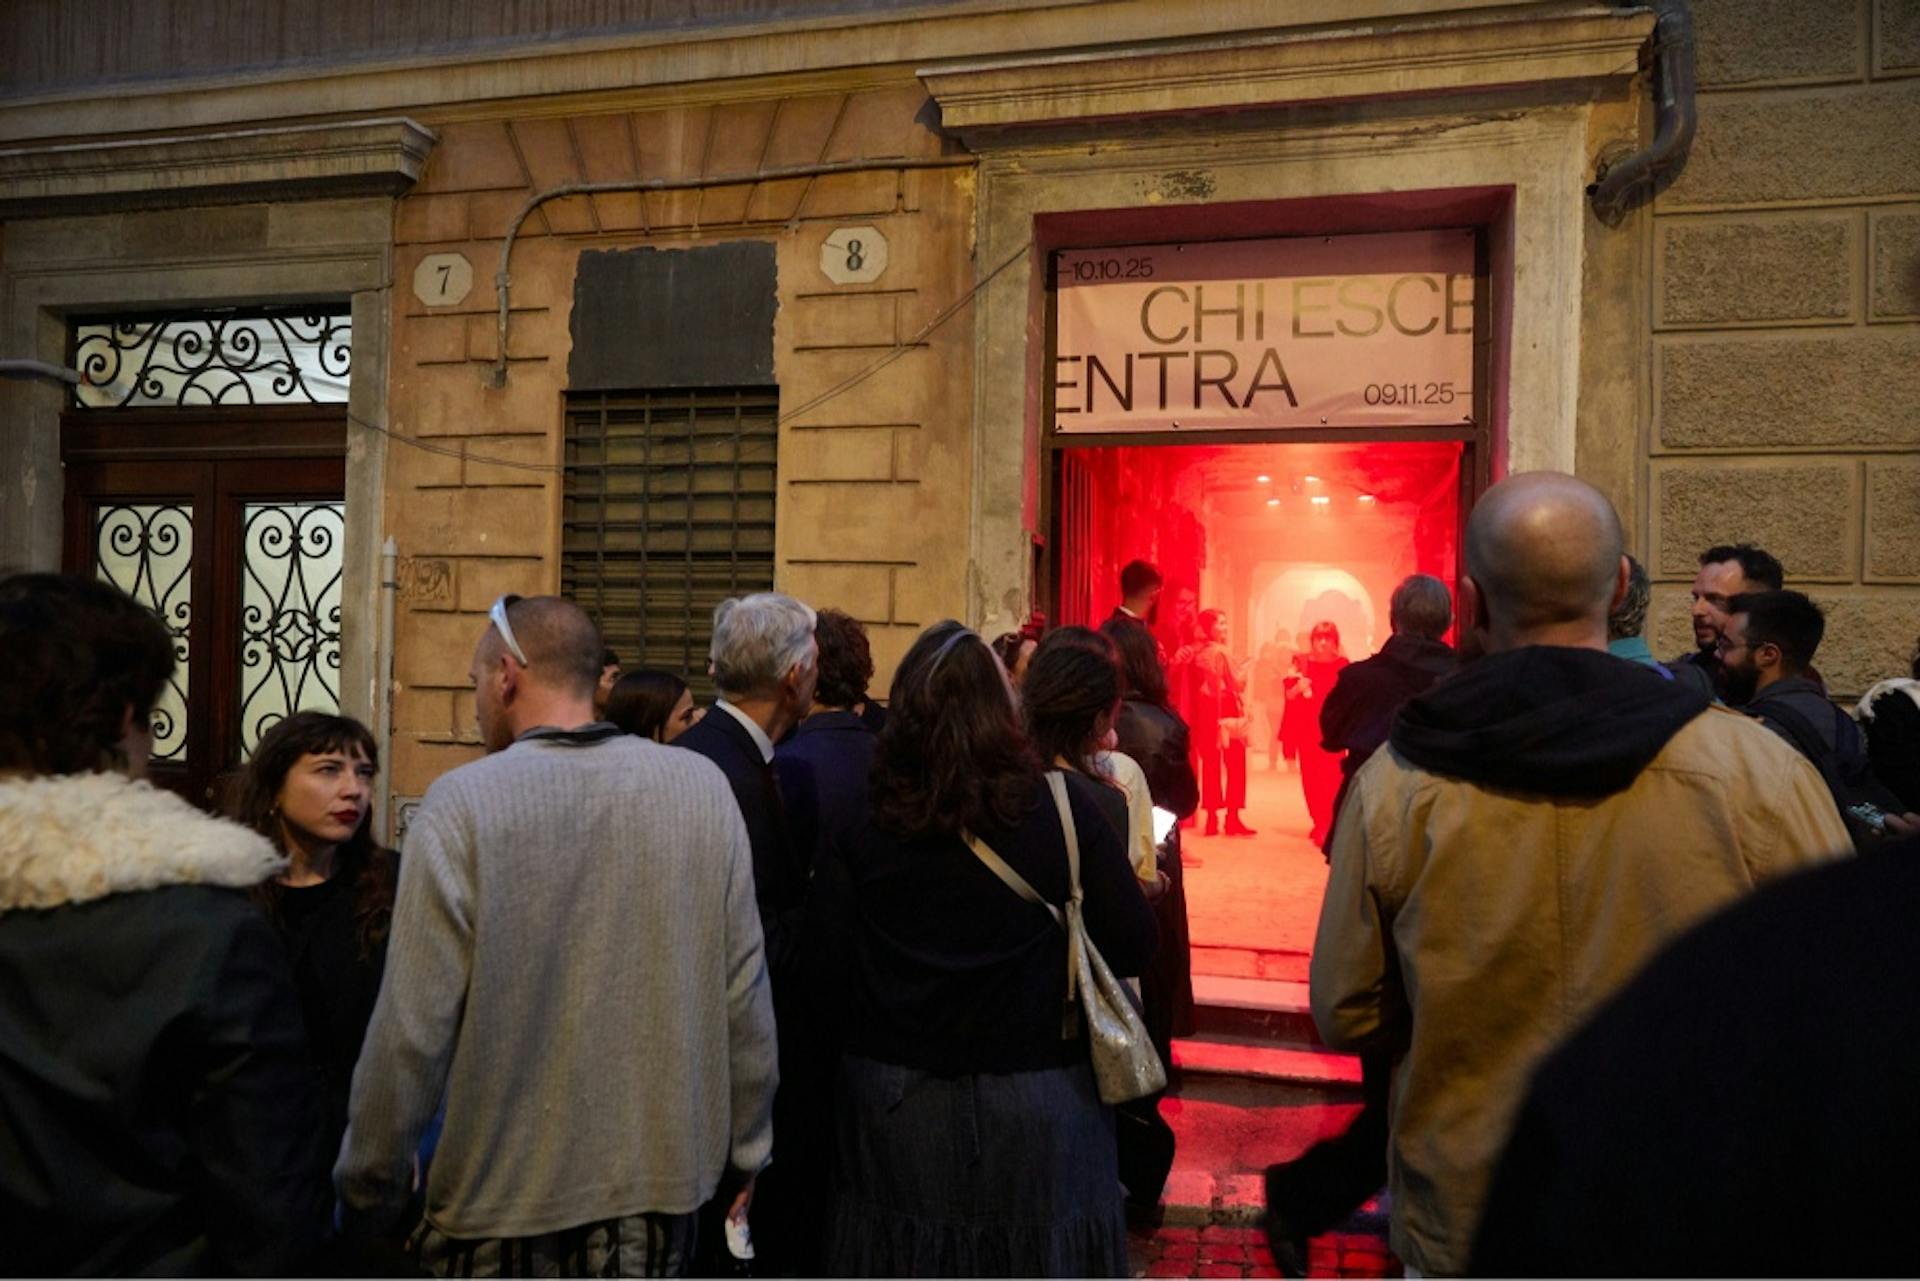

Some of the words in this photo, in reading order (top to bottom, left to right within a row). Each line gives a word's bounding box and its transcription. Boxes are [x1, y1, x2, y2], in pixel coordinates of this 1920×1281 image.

[847, 239, 863, 271] 8
[436, 265, 451, 296] 7
[1140, 282, 1264, 345] CHI
